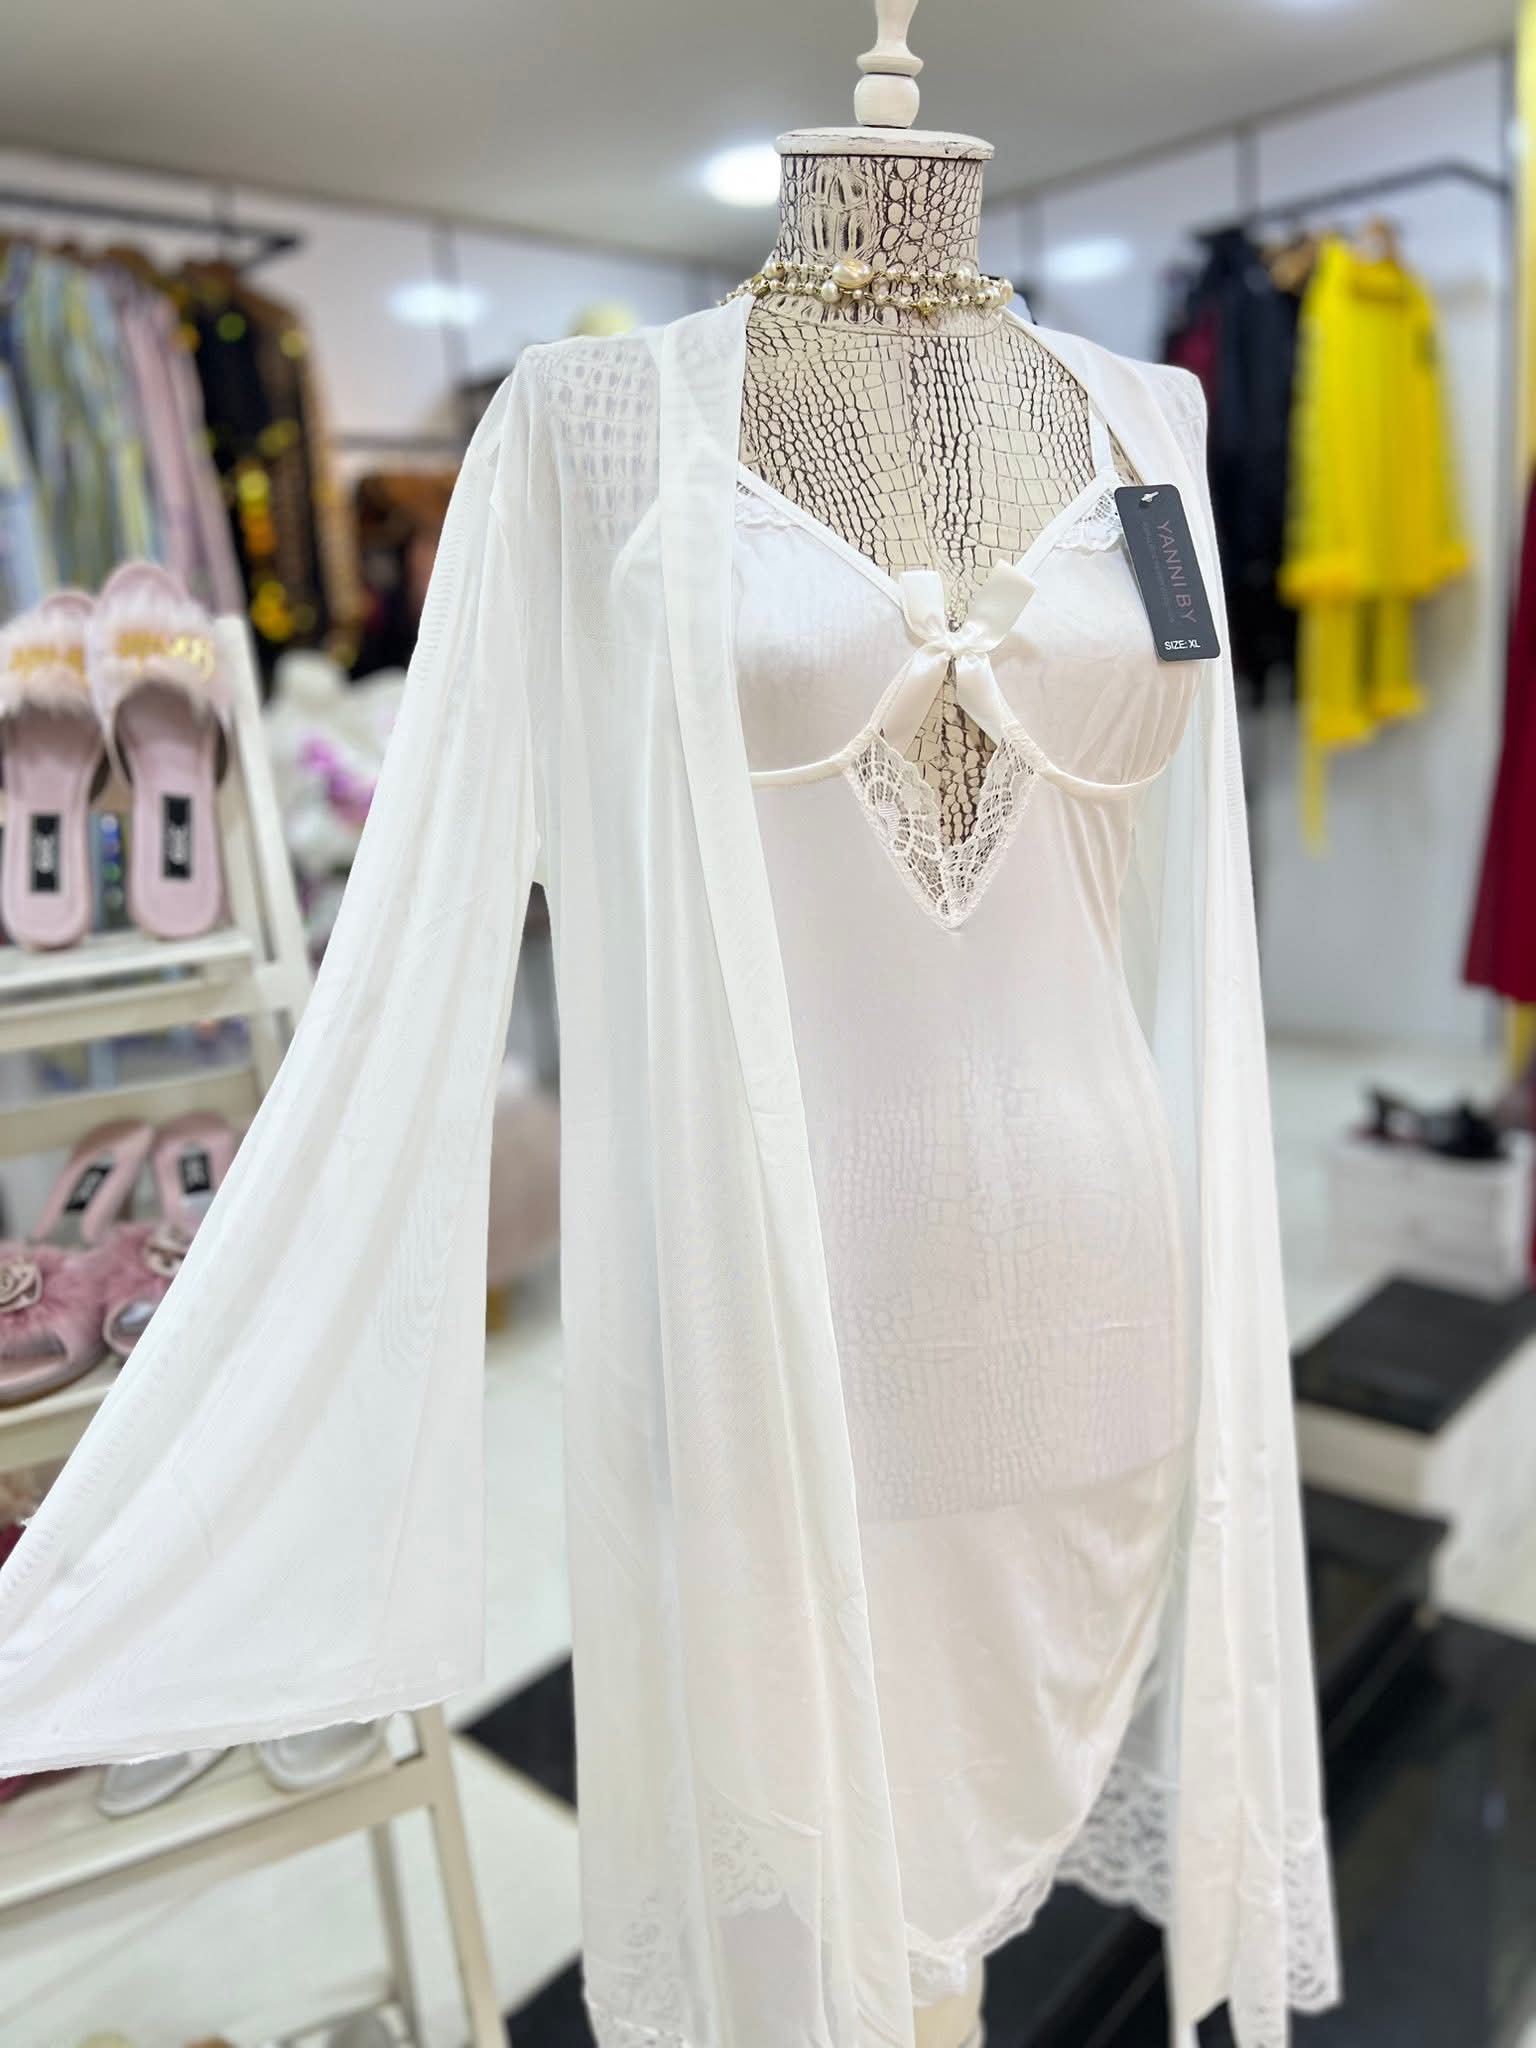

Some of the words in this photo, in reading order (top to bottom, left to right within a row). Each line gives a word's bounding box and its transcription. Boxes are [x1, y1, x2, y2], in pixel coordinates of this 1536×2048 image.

[1157, 520, 1187, 587] YANNI
[1175, 594, 1198, 623] BY
[1164, 639, 1188, 651] SIZE:
[1188, 639, 1201, 649] XL
